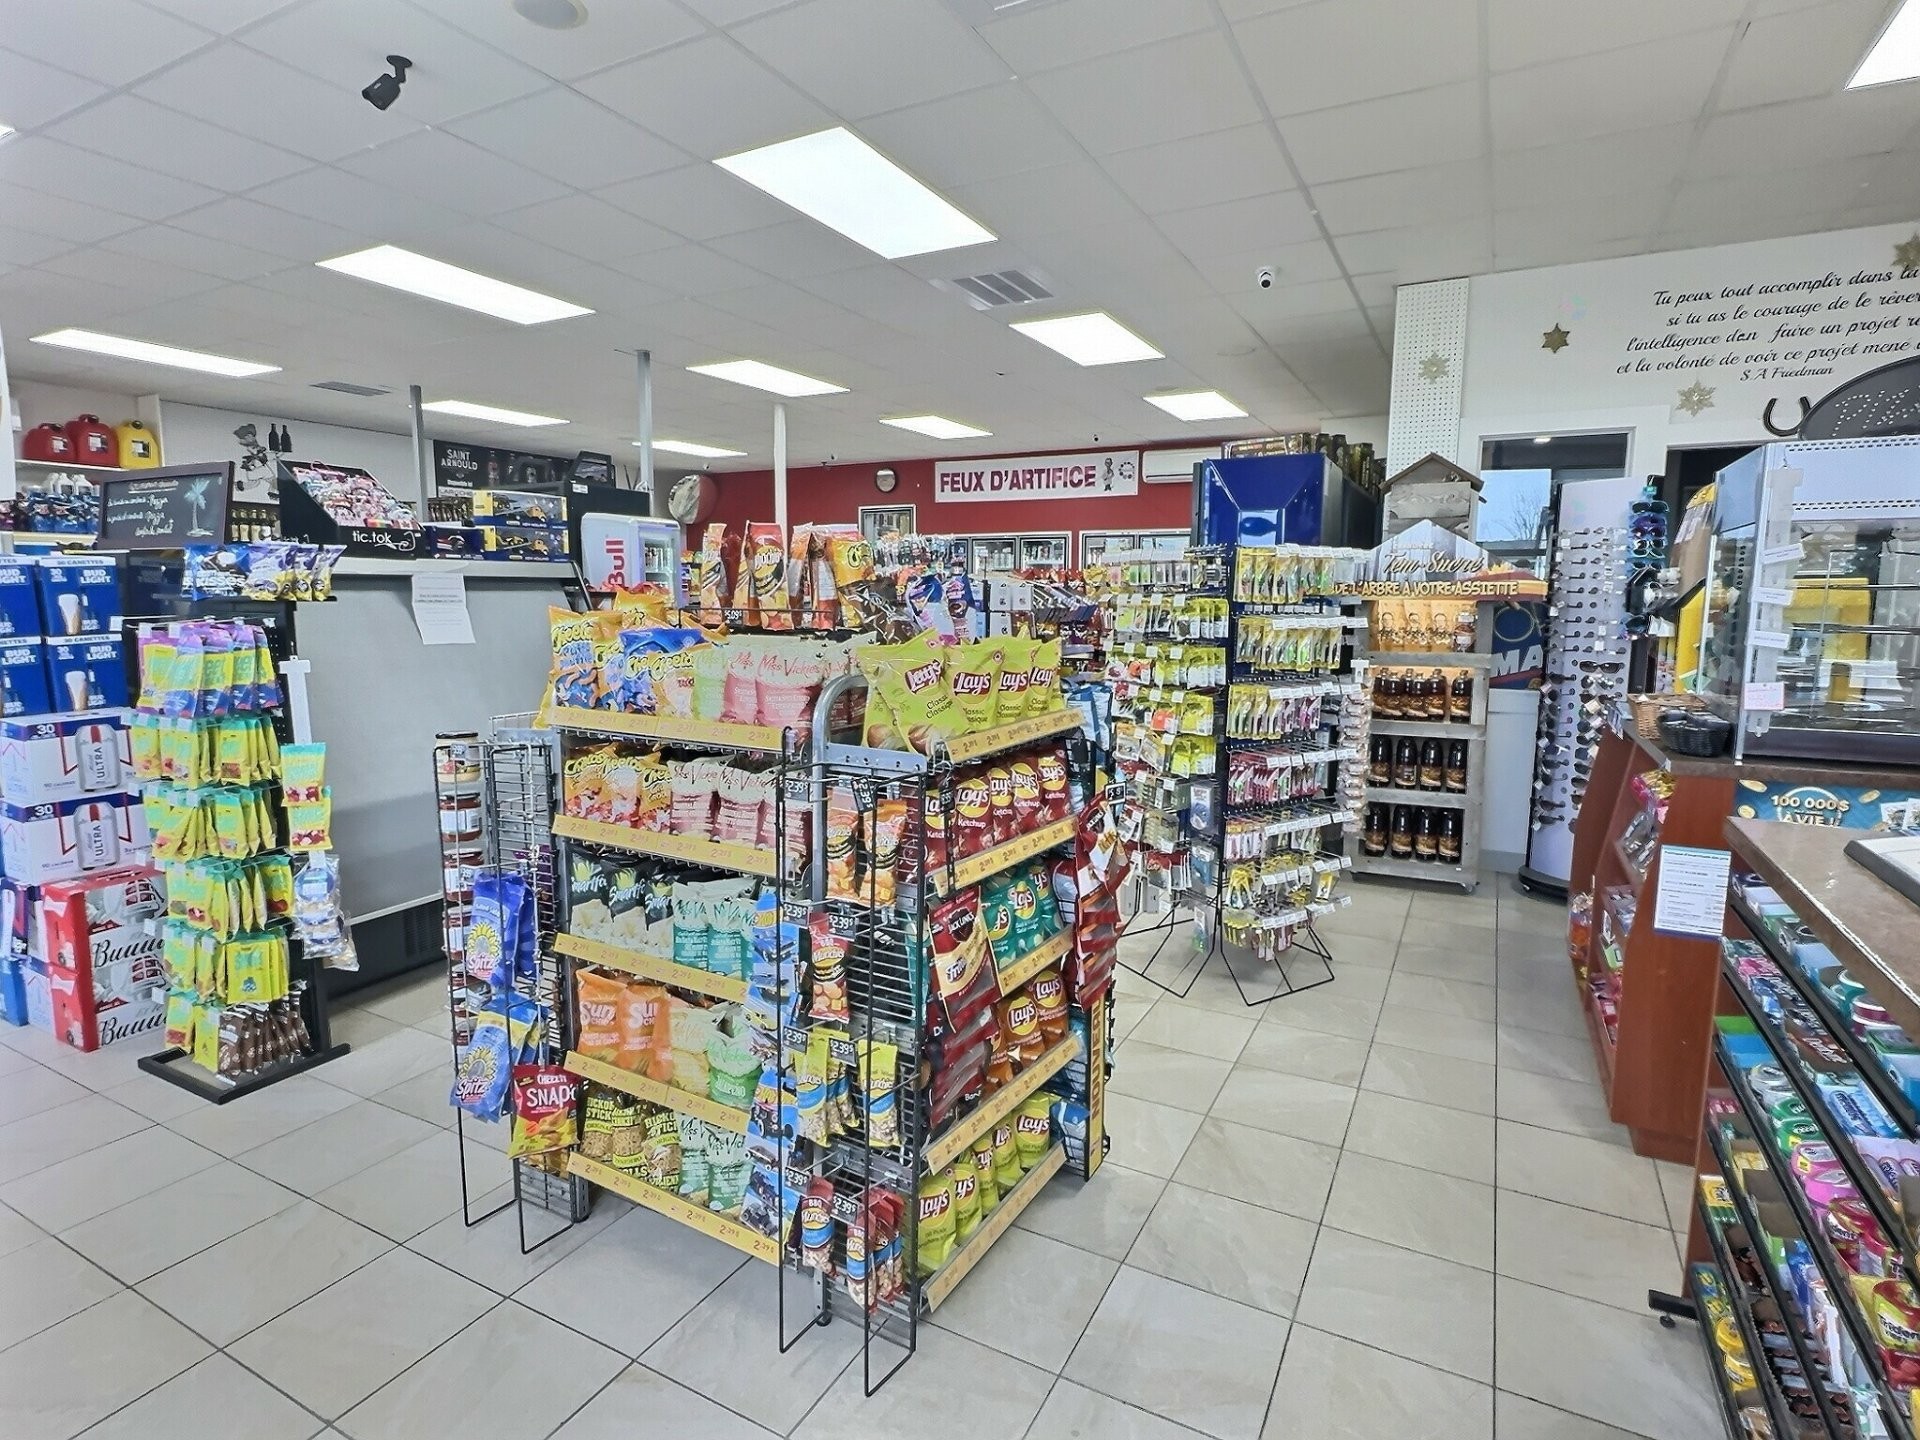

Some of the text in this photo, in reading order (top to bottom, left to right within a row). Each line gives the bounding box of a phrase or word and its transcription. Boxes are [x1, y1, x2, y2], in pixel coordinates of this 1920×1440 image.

[1654, 290, 1672, 306] Tu
[1674, 291, 1715, 308] peux
[1721, 283, 1754, 299] tout
[1758, 271, 1842, 294] accomplir
[1848, 270, 1893, 285] dans
[1666, 313, 1682, 326] si
[1686, 312, 1701, 324] tu
[1707, 312, 1729, 322] as
[1733, 304, 1748, 320] le
[1754, 302, 1822, 318] courage
[1827, 296, 1849, 310] de
[1855, 291, 1872, 308] le
[1626, 333, 1721, 352] l'intelligence
[1768, 322, 1816, 344] faire
[1820, 323, 1841, 335] un
[1845, 315, 1901, 337] projet
[1616, 361, 1630, 375] et
[1635, 357, 1653, 373] la
[1656, 353, 1716, 371] volonté
[1719, 351, 1741, 366] de
[1744, 349, 1779, 364] voir
[1784, 349, 1803, 361] ce
[1804, 341, 1861, 363] projet
[441, 458, 478, 471] ARNOULD
[447, 449, 471, 461] SAINT
[940, 465, 1096, 493] FEUX D'ARTIFICE
[1352, 581, 1400, 596] L'ARBRE
[1413, 581, 1453, 596] VOTRE
[1454, 581, 1519, 596] ASSIETTE
[955, 672, 991, 695] Lay's
[36, 723, 55, 735] 30
[97, 746, 105, 778] ULTRA
[34, 804, 53, 816] 30
[1771, 795, 1800, 807] 100
[1804, 797, 1850, 812] 000$
[1795, 814, 1825, 825] VIE
[93, 824, 104, 856] ULTRA
[467, 954, 496, 973] Spitz
[1036, 978, 1061, 999] Lay's
[1009, 1002, 1035, 1027] Lay's
[457, 1076, 489, 1099] Spitz
[1018, 1115, 1050, 1134] Lay's
[919, 1190, 949, 1219] Lay's
